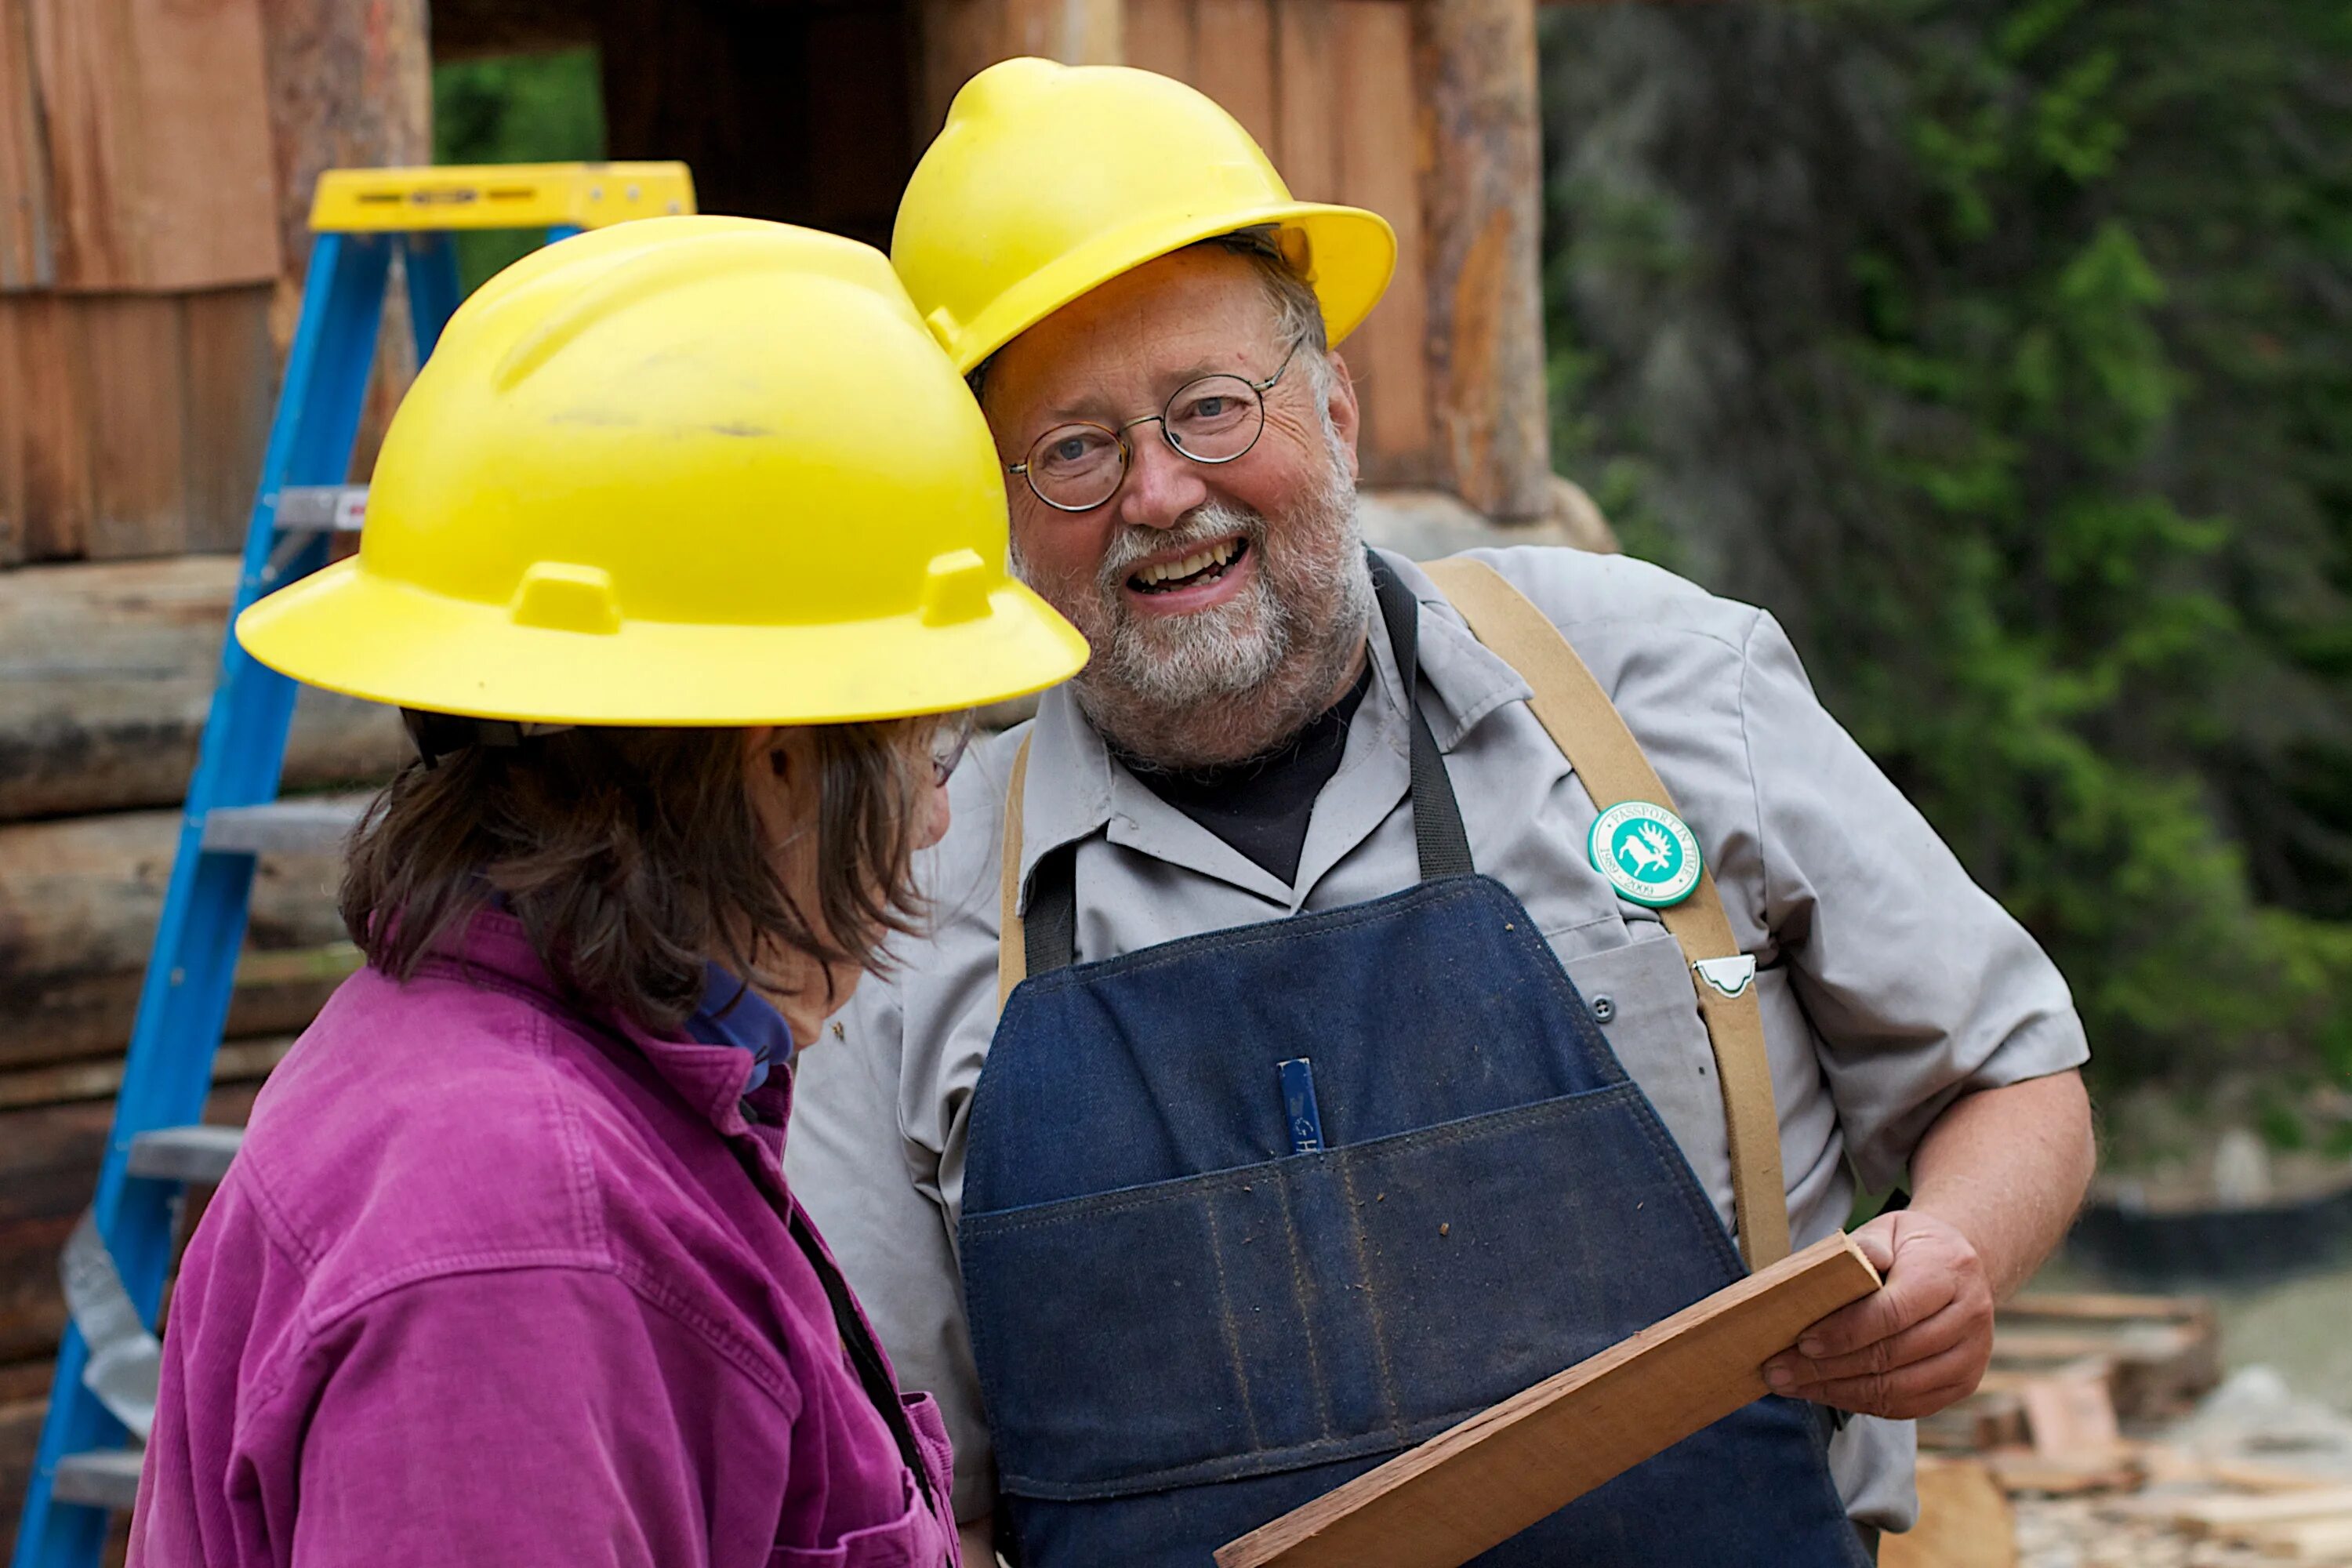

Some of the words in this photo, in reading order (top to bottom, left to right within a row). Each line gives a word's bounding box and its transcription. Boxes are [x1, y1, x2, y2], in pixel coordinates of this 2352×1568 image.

[1611, 806, 1676, 828] PASSPORT
[1675, 826, 1689, 842] IN
[1683, 844, 1695, 877] TIME
[1600, 848, 1619, 873] 1989
[1624, 877, 1654, 897] 2009
